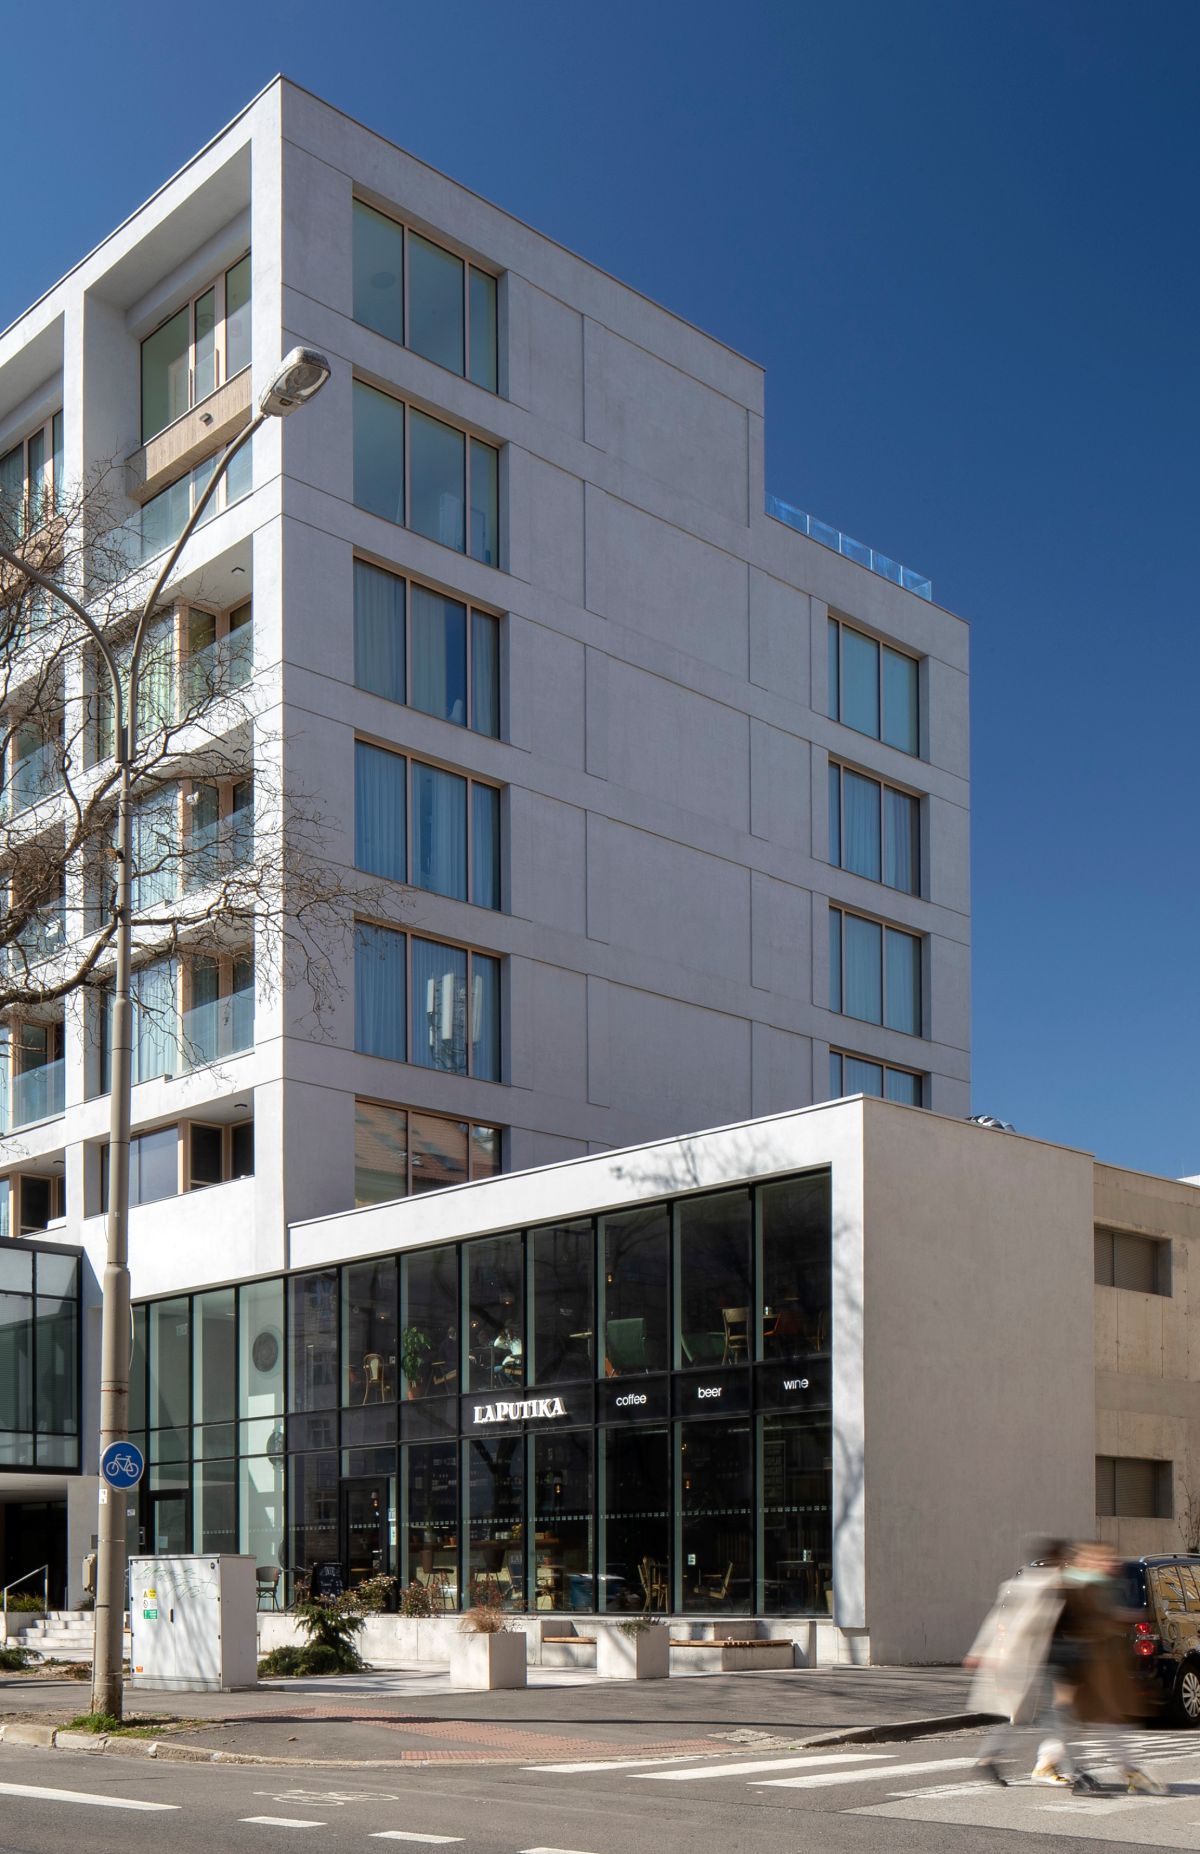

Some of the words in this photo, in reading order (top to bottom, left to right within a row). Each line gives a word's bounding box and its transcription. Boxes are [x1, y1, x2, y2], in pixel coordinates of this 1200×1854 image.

[783, 1378, 809, 1390] wine
[697, 1387, 722, 1399] beer
[616, 1394, 647, 1406] coffee
[473, 1397, 567, 1424] LAPUTIKA
